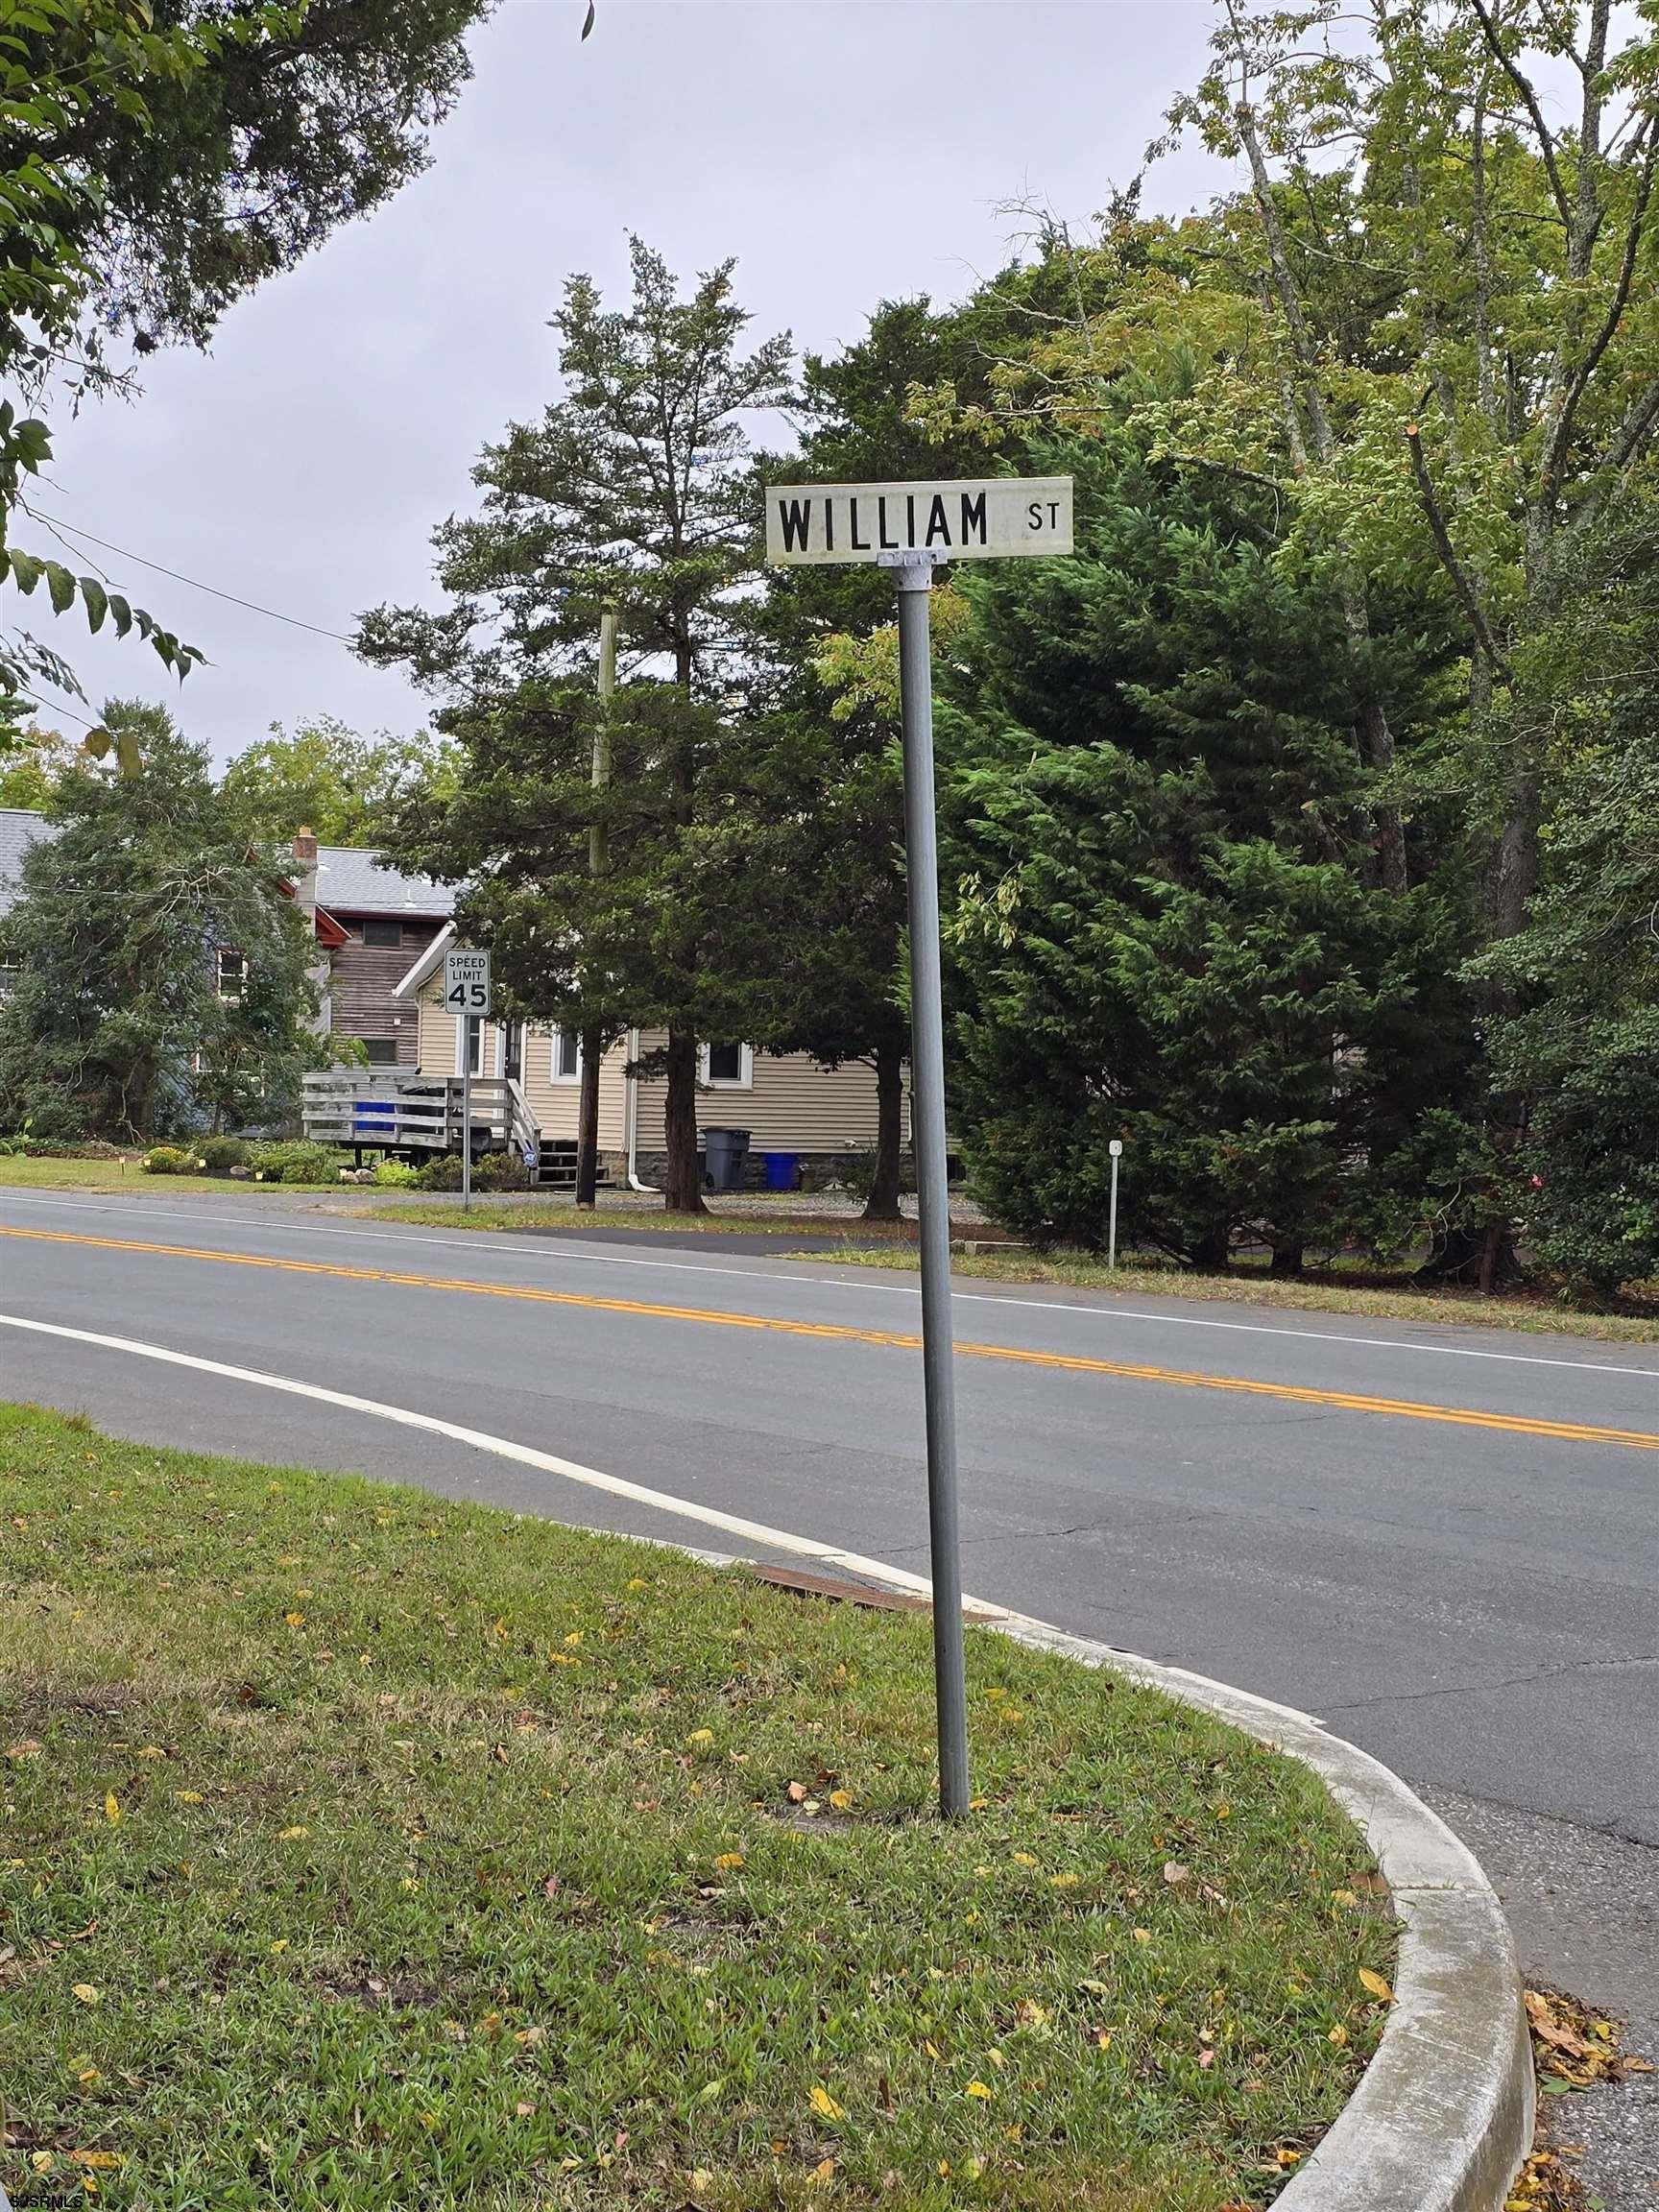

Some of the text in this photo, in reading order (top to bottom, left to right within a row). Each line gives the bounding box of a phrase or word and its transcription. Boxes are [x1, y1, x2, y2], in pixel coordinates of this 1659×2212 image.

[779, 492, 1060, 552] WILLIAM ST
[448, 957, 486, 968] SPEED
[452, 971, 482, 981] LIMIT
[448, 983, 487, 1007] 45
